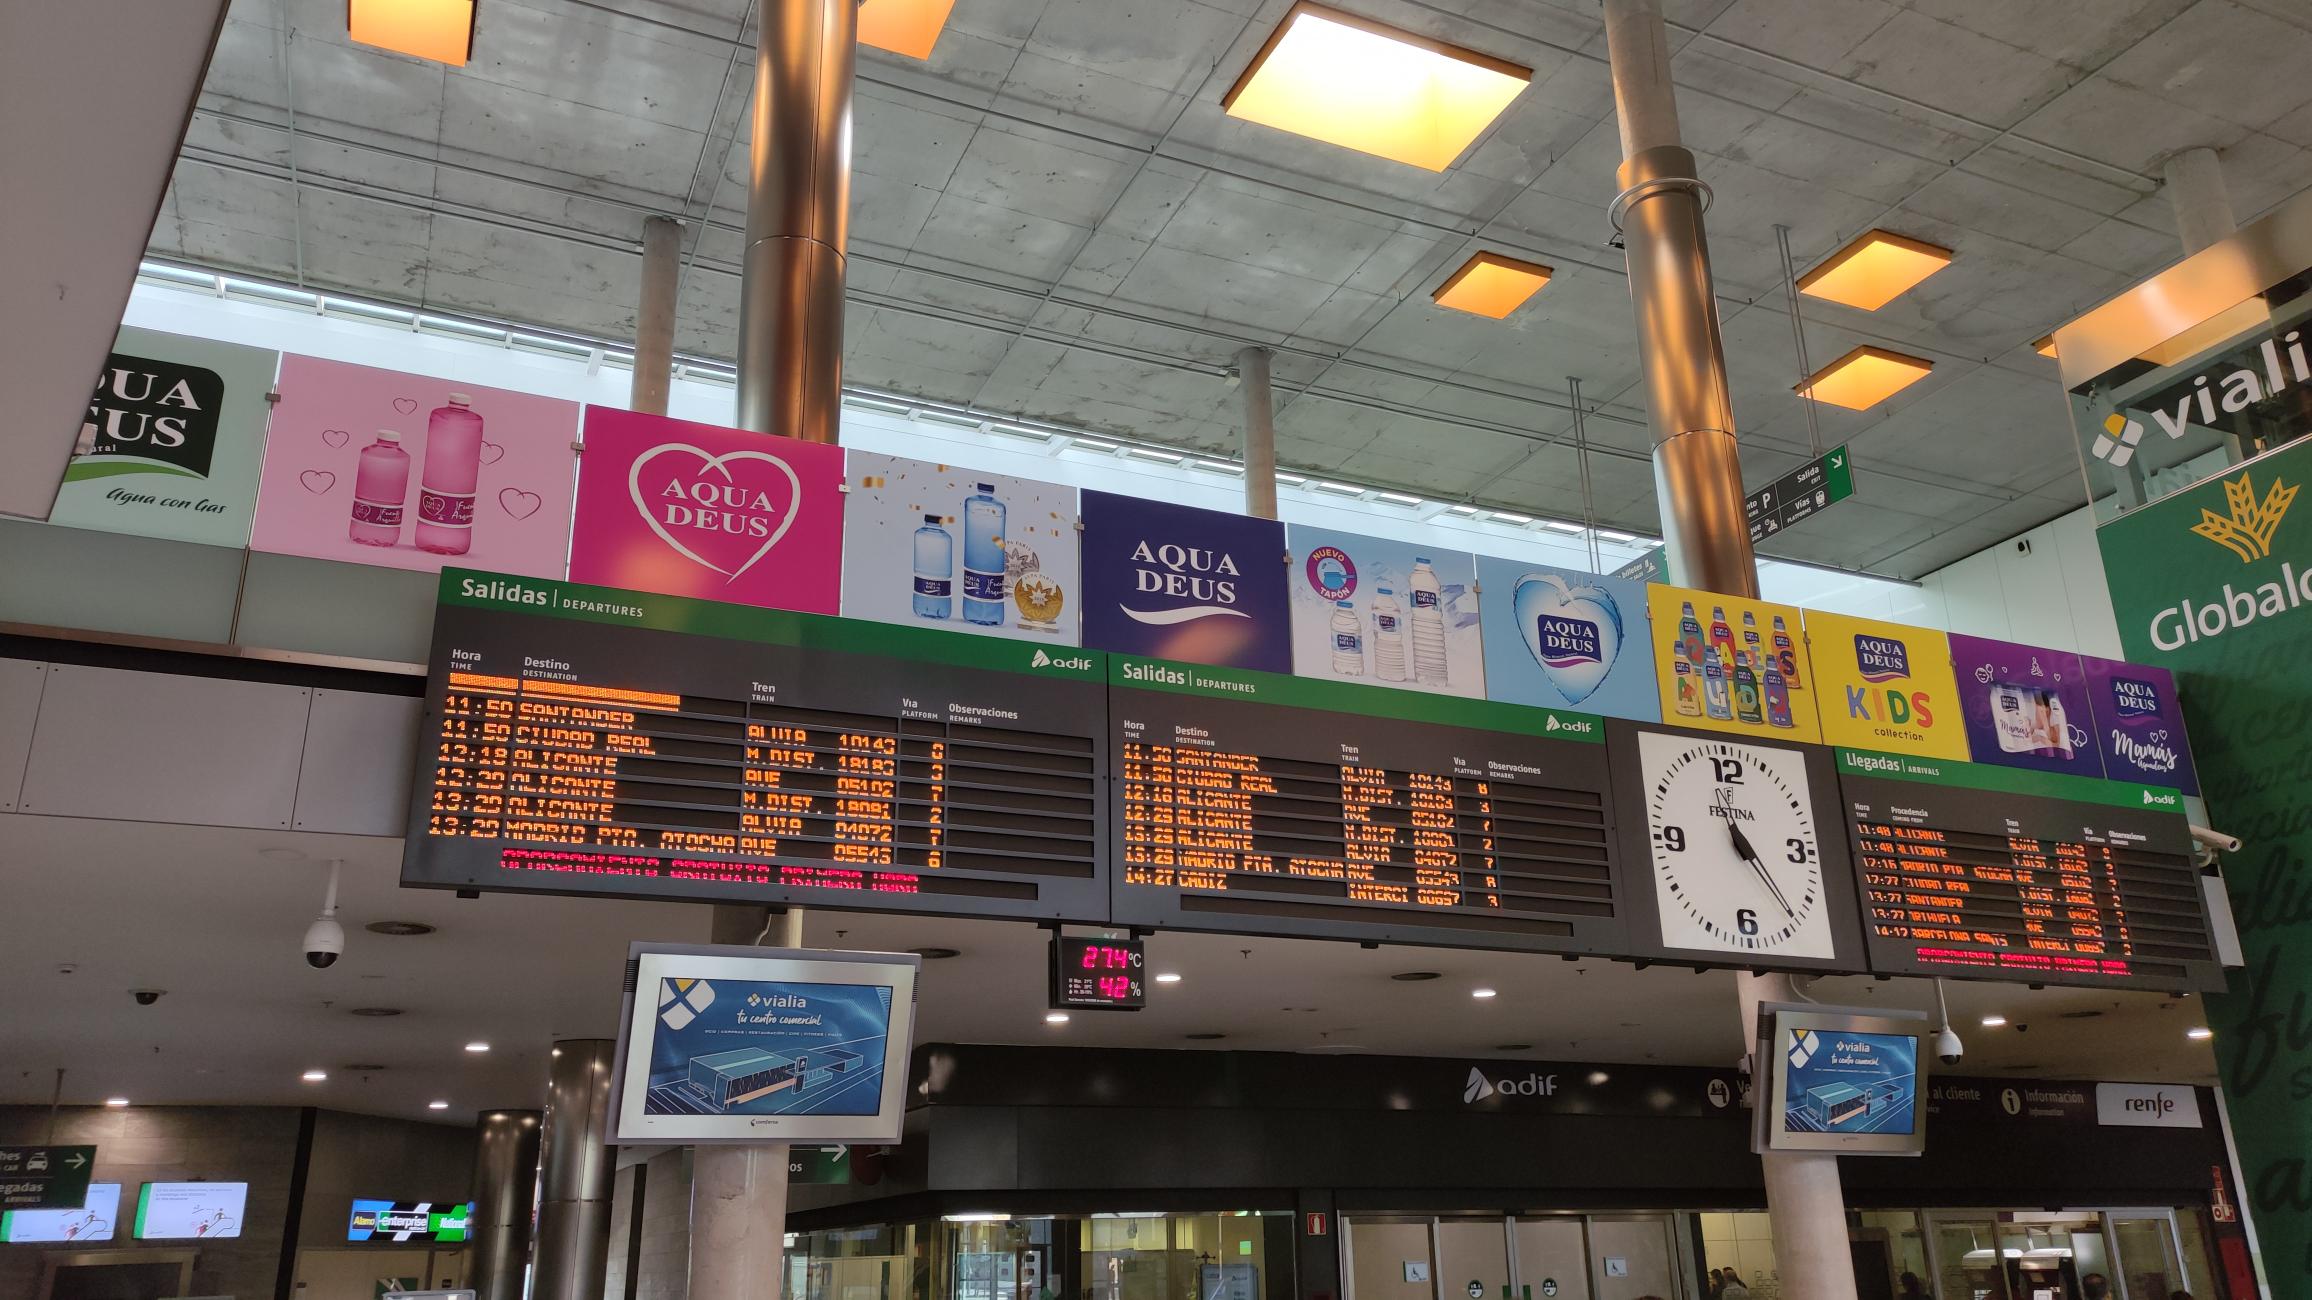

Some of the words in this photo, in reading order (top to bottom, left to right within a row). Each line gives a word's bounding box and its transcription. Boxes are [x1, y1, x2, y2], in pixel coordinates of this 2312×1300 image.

[2150, 330, 2312, 440] viali
[1797, 465, 1820, 484] Salida
[660, 477, 776, 513] AQUA
[160, 497, 191, 509] con
[664, 504, 769, 538] DEUS
[1130, 540, 1241, 577] AQUA
[1312, 549, 1345, 562] NUEVO
[1136, 569, 1237, 604] DEUS
[1320, 586, 1350, 599] TAPÓN
[461, 578, 547, 606] Salidas
[563, 598, 643, 618] DEPARTURES
[1544, 620, 1595, 638] AQUA
[1547, 635, 1594, 652] DEUS
[1860, 640, 1903, 656] AQUA
[452, 648, 482, 662] Hora
[1863, 653, 1903, 669] DEUS
[450, 661, 472, 671] TIME
[524, 656, 570, 671] Destino
[1052, 657, 1093, 671] adif
[523, 669, 578, 682] DESTINATION
[1123, 662, 1185, 685] Salidas
[1196, 678, 1256, 694] DEPARTURES
[752, 681, 776, 693] Tren
[2114, 681, 2156, 698] AQUA
[752, 694, 775, 702] TRAIN
[2119, 695, 2156, 711] DEUS
[948, 703, 1019, 720] Observaciones
[1846, 685, 1934, 728] KIDS
[902, 709, 938, 720] PLATFORM
[949, 715, 982, 725] REMARKS
[1124, 719, 1145, 730] Hora
[1175, 725, 1209, 738] Destino
[1562, 720, 1593, 733] adif
[1124, 731, 1140, 739] TIME
[1175, 736, 1215, 747] DESTINATION
[1875, 728, 1924, 741] collection
[1341, 744, 1359, 754] Tren
[2112, 729, 2178, 770] Mamás
[1341, 754, 1359, 762] TRAIN
[1846, 752, 1900, 771] Llegadas
[1908, 765, 1940, 776] ARRIVALS
[1454, 767, 1482, 776] PLATFORM
[1488, 760, 1541, 775] Observaciones
[1709, 757, 1745, 785] 12
[1709, 806, 1755, 821] FESTINA
[1664, 826, 1686, 852] 9
[1786, 838, 1807, 864] 3
[1736, 909, 1759, 936] 6
[1099, 976, 1129, 998] 42
[762, 995, 807, 1009] vialia
[737, 1010, 748, 1025] tu
[750, 1011, 778, 1025] centro
[779, 1013, 822, 1027] comercial
[1844, 1042, 1871, 1053] vialia
[1497, 1073, 1558, 1097] adif
[1946, 1087, 1981, 1101] cliente
[2025, 1089, 2084, 1105] Información
[2125, 1091, 2174, 1119] renfe
[381, 1216, 427, 1229] enterprise
